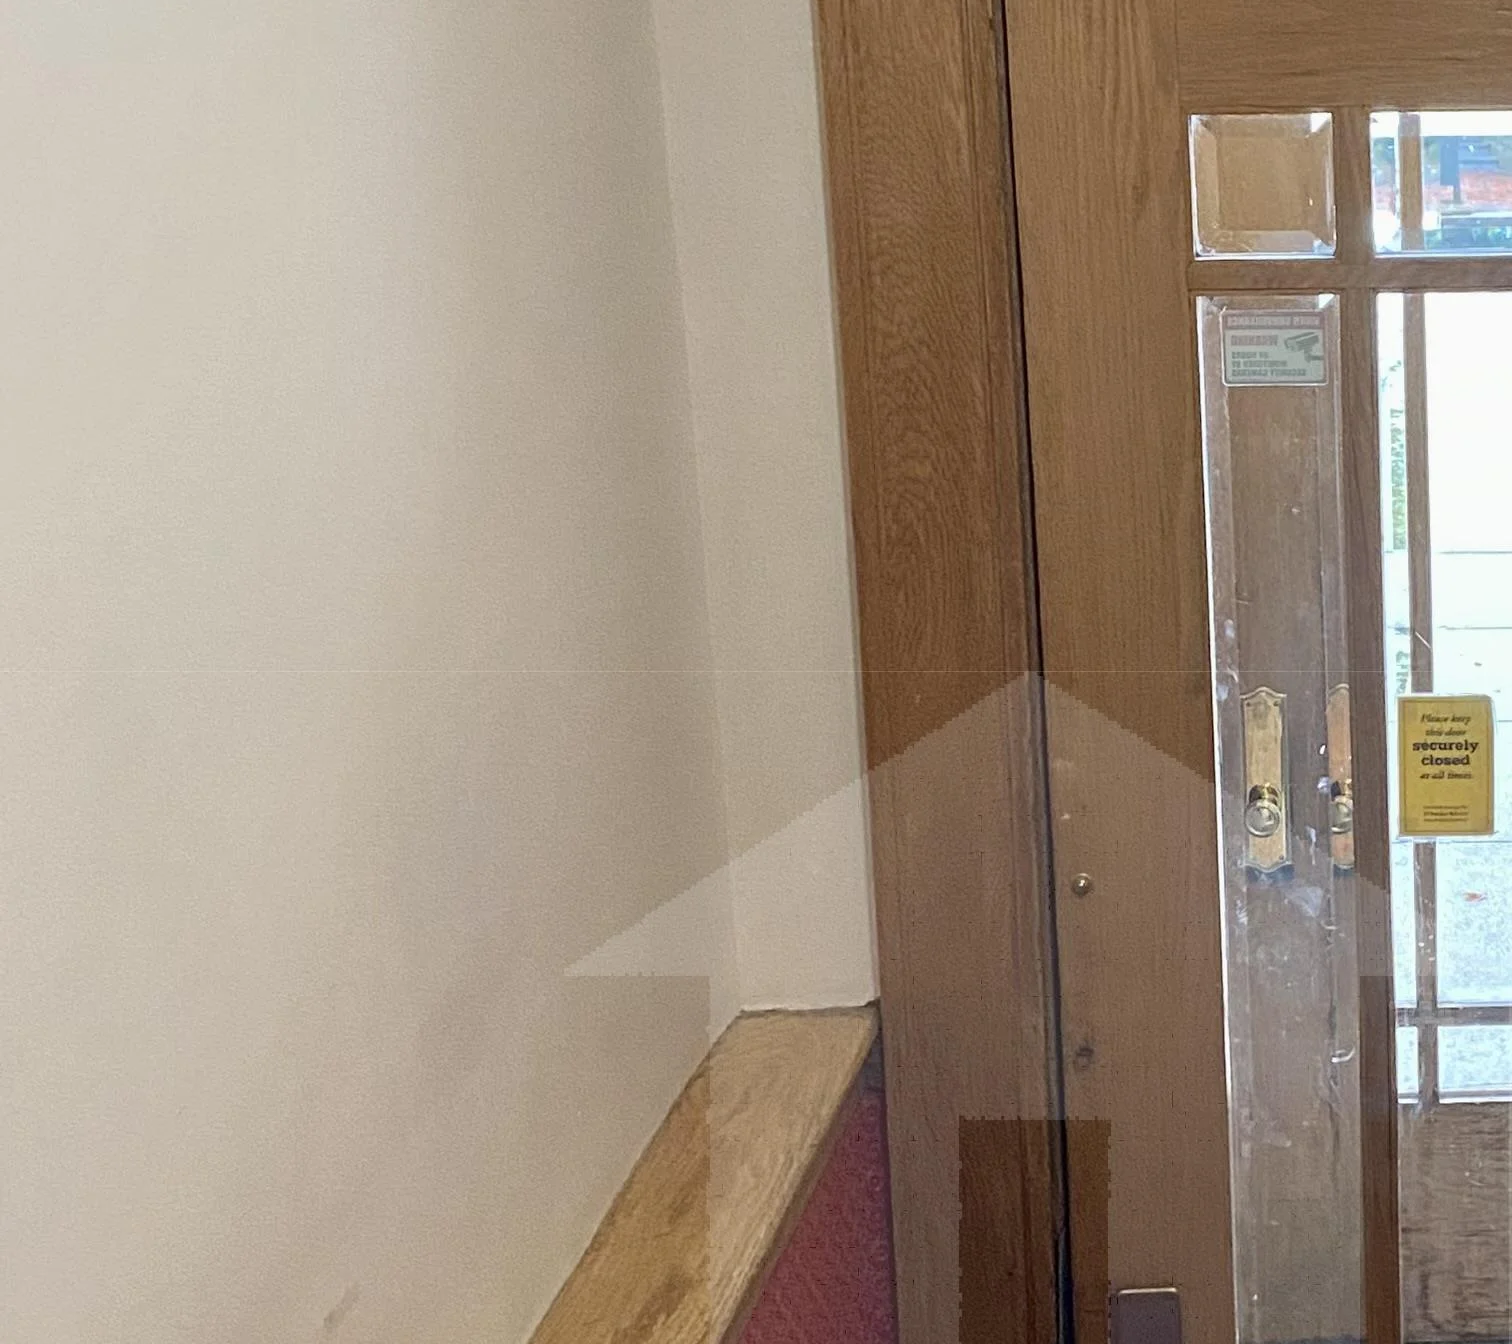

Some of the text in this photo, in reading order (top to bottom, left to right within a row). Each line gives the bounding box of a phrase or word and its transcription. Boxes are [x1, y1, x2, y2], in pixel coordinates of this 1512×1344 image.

[1421, 713, 1449, 723] Please
[1412, 739, 1479, 753] securely
[1421, 754, 1471, 766] closed
